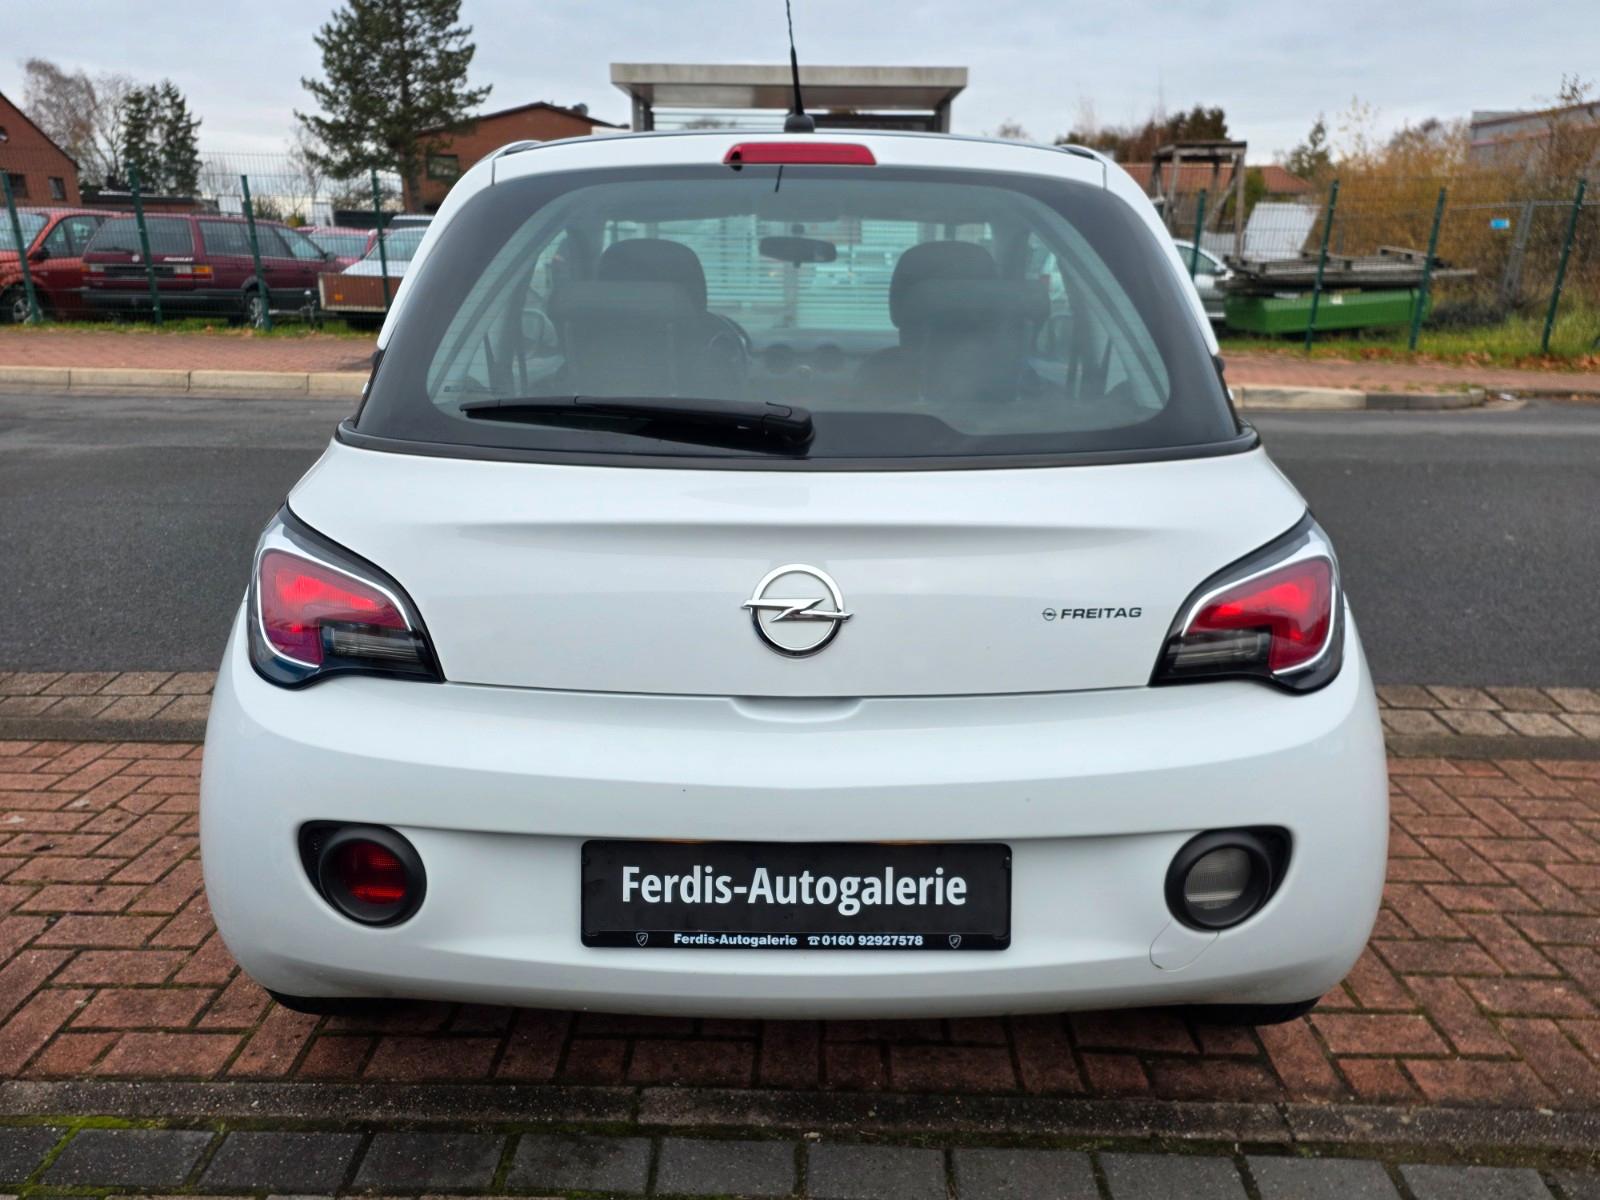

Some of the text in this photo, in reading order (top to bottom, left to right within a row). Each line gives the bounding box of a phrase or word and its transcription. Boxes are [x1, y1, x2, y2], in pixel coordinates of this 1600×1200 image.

[1060, 607, 1143, 619] FREITAG
[622, 864, 967, 916] Ferdis-Autogalerie
[673, 933, 924, 947] Ferdis-Autogalerie 0160 92927578
